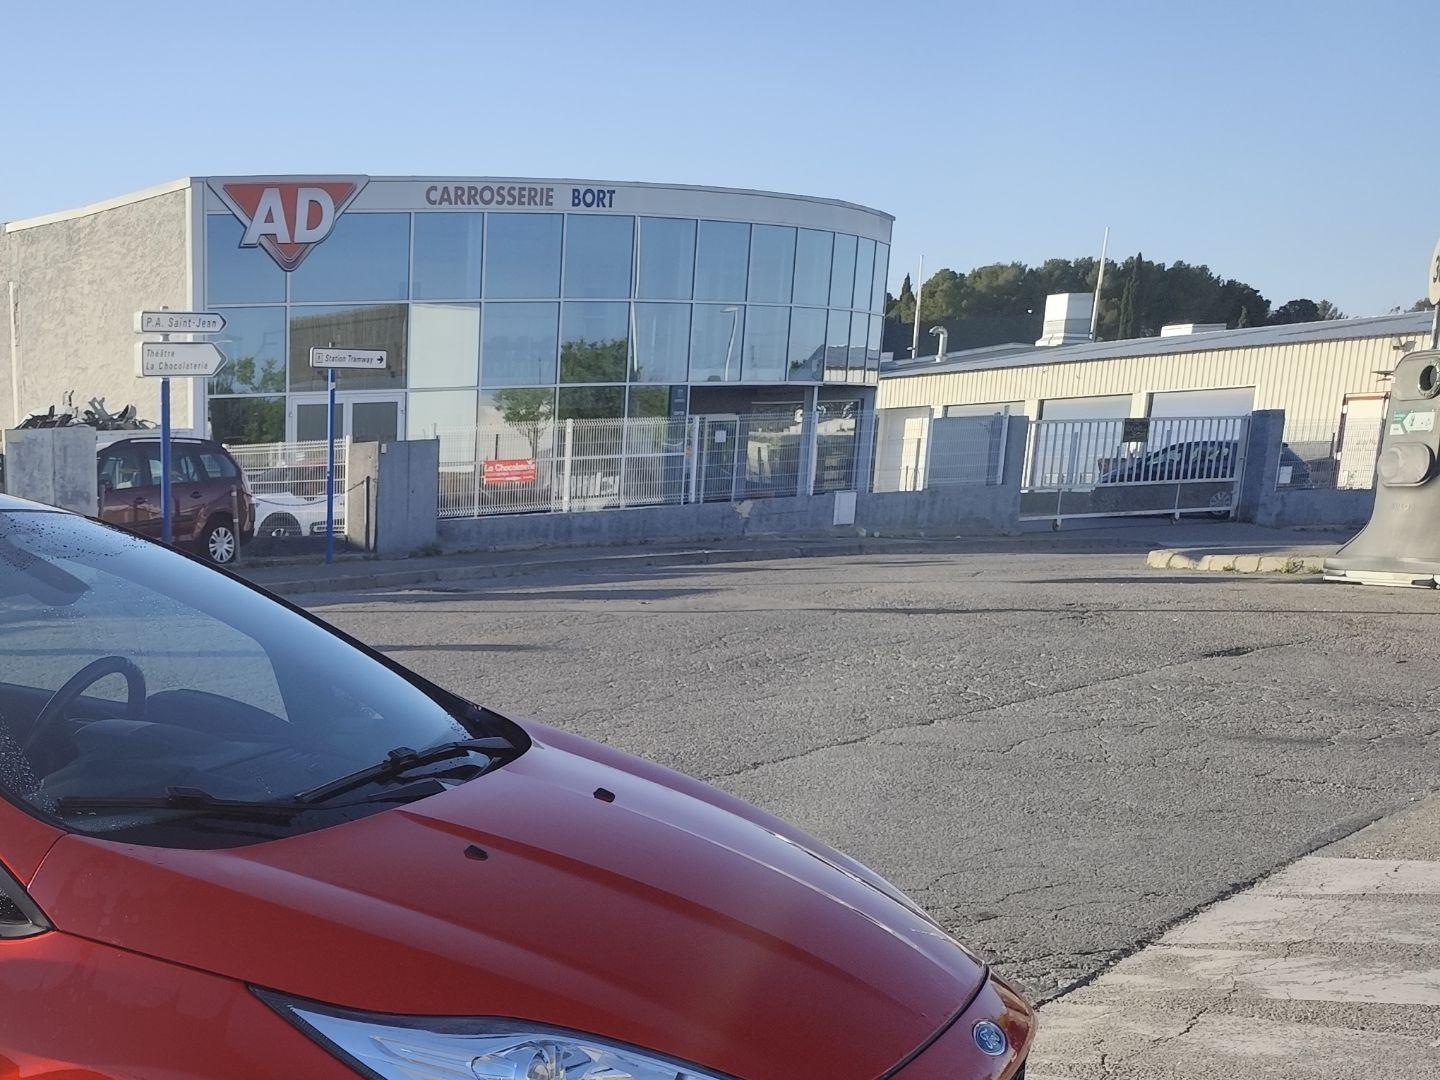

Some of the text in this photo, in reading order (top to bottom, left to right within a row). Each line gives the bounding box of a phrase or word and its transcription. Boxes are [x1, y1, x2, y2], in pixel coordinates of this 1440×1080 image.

[425, 185, 616, 208] CARROSSERIE BORT
[241, 186, 335, 245] AD
[146, 316, 217, 328] P.A. Saint-Jean
[325, 354, 374, 364] Station Tramway
[146, 361, 209, 370] La Chocolaterie
